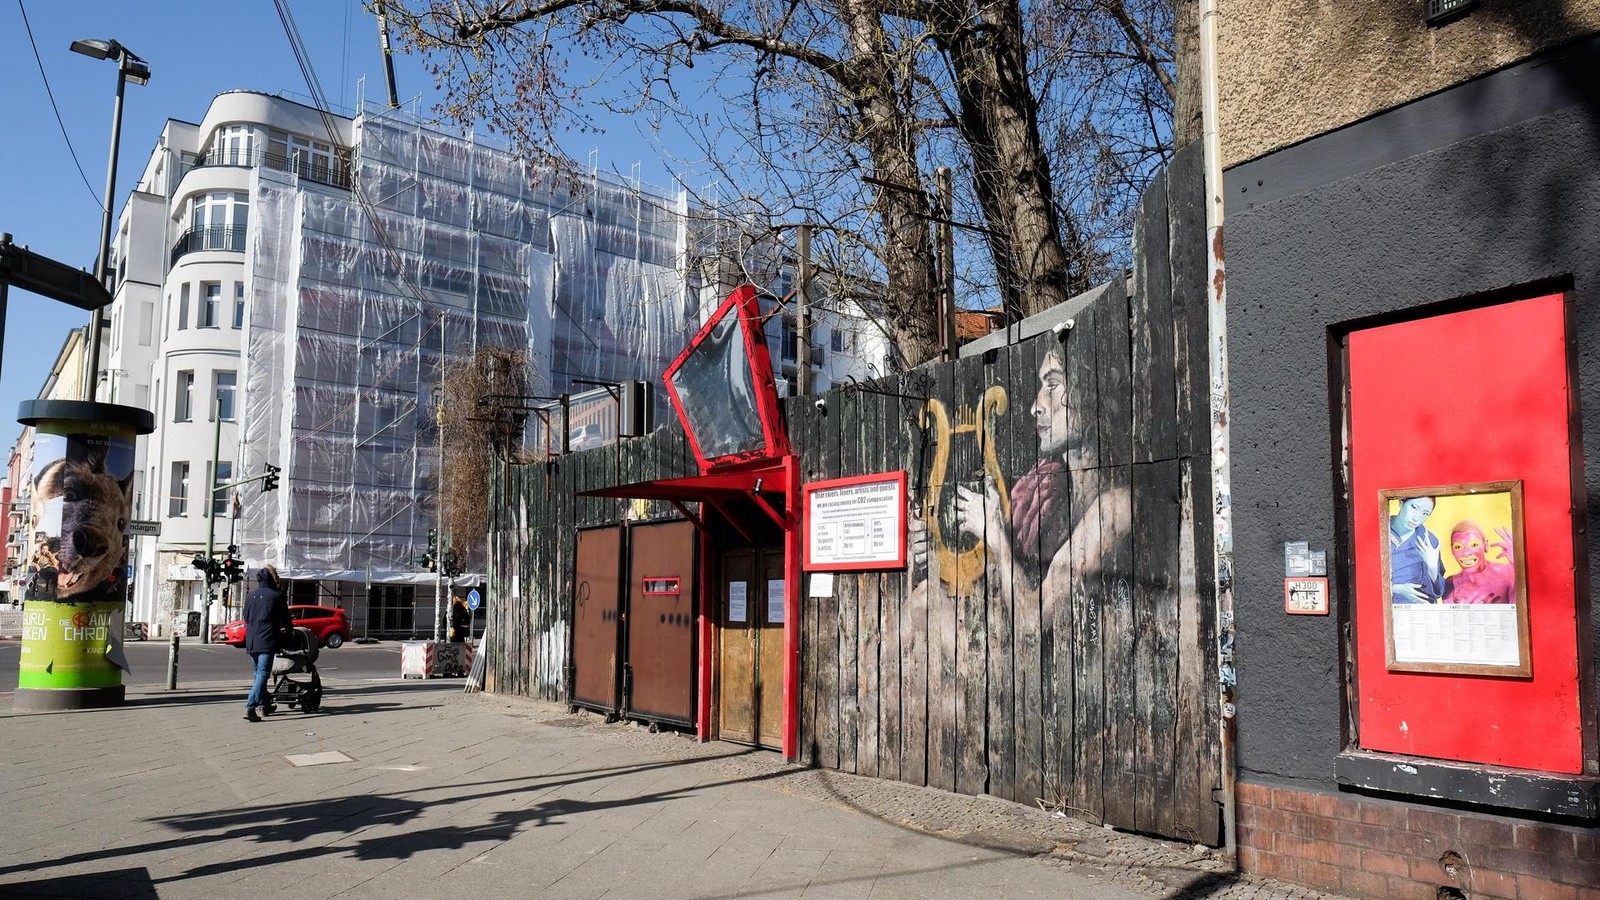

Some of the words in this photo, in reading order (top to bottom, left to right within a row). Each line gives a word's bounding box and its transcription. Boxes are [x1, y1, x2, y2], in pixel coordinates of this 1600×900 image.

[855, 486, 869, 495] artists
[870, 484, 879, 493] and
[880, 483, 896, 493] guests
[867, 495, 894, 504] compensation
[59, 619, 71, 627] DIE
